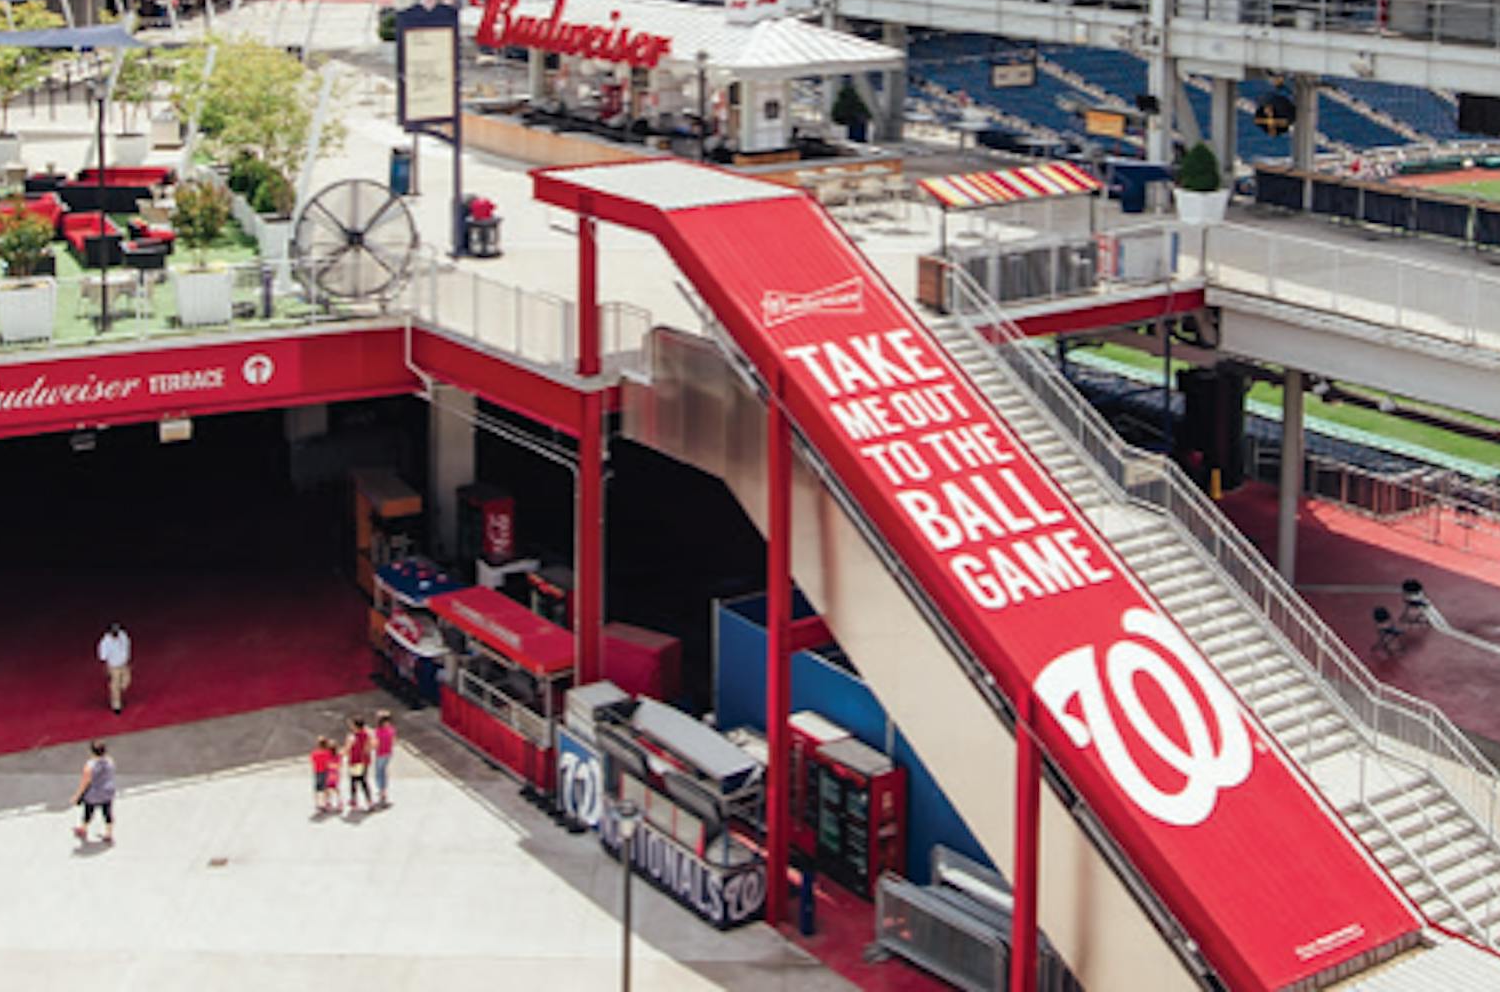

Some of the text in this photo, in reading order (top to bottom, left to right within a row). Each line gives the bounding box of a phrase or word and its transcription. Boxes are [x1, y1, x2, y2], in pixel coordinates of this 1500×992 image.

[148, 368, 226, 396] TERRACE
[785, 328, 943, 397] TAKE
[830, 385, 970, 440] ME OUT
[861, 422, 1014, 486] TO THE
[897, 468, 1063, 550] BALL
[951, 529, 1112, 610] GAME
[1034, 608, 1253, 826] W
[602, 798, 724, 923] NTIONALS
